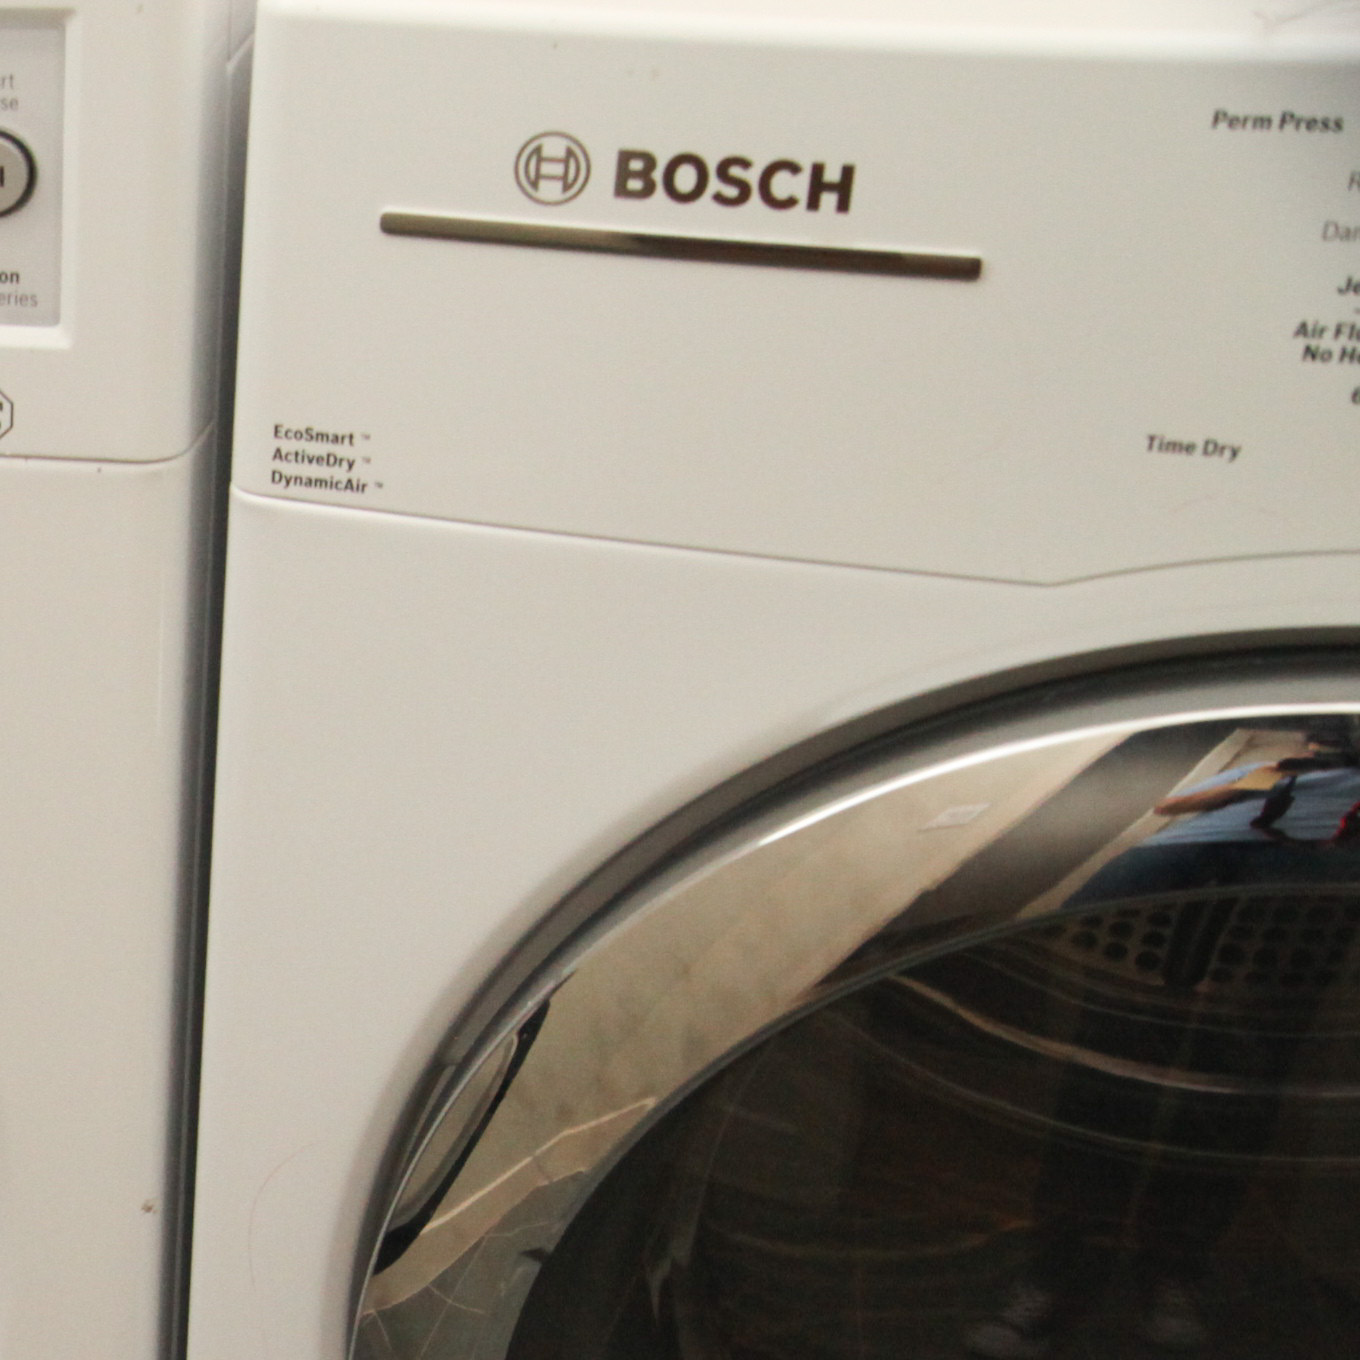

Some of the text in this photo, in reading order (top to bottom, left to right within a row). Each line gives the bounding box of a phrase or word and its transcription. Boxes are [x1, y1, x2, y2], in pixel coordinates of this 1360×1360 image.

[1211, 110, 1344, 133] Perm Press
[613, 148, 857, 214] BOSCH
[1293, 320, 1328, 340] Air
[1302, 344, 1333, 363] No
[273, 424, 354, 447] EcoSmart
[272, 447, 355, 473] ActiveDry
[1147, 434, 1242, 463] Time Dry
[271, 469, 368, 493] DynamicAir
